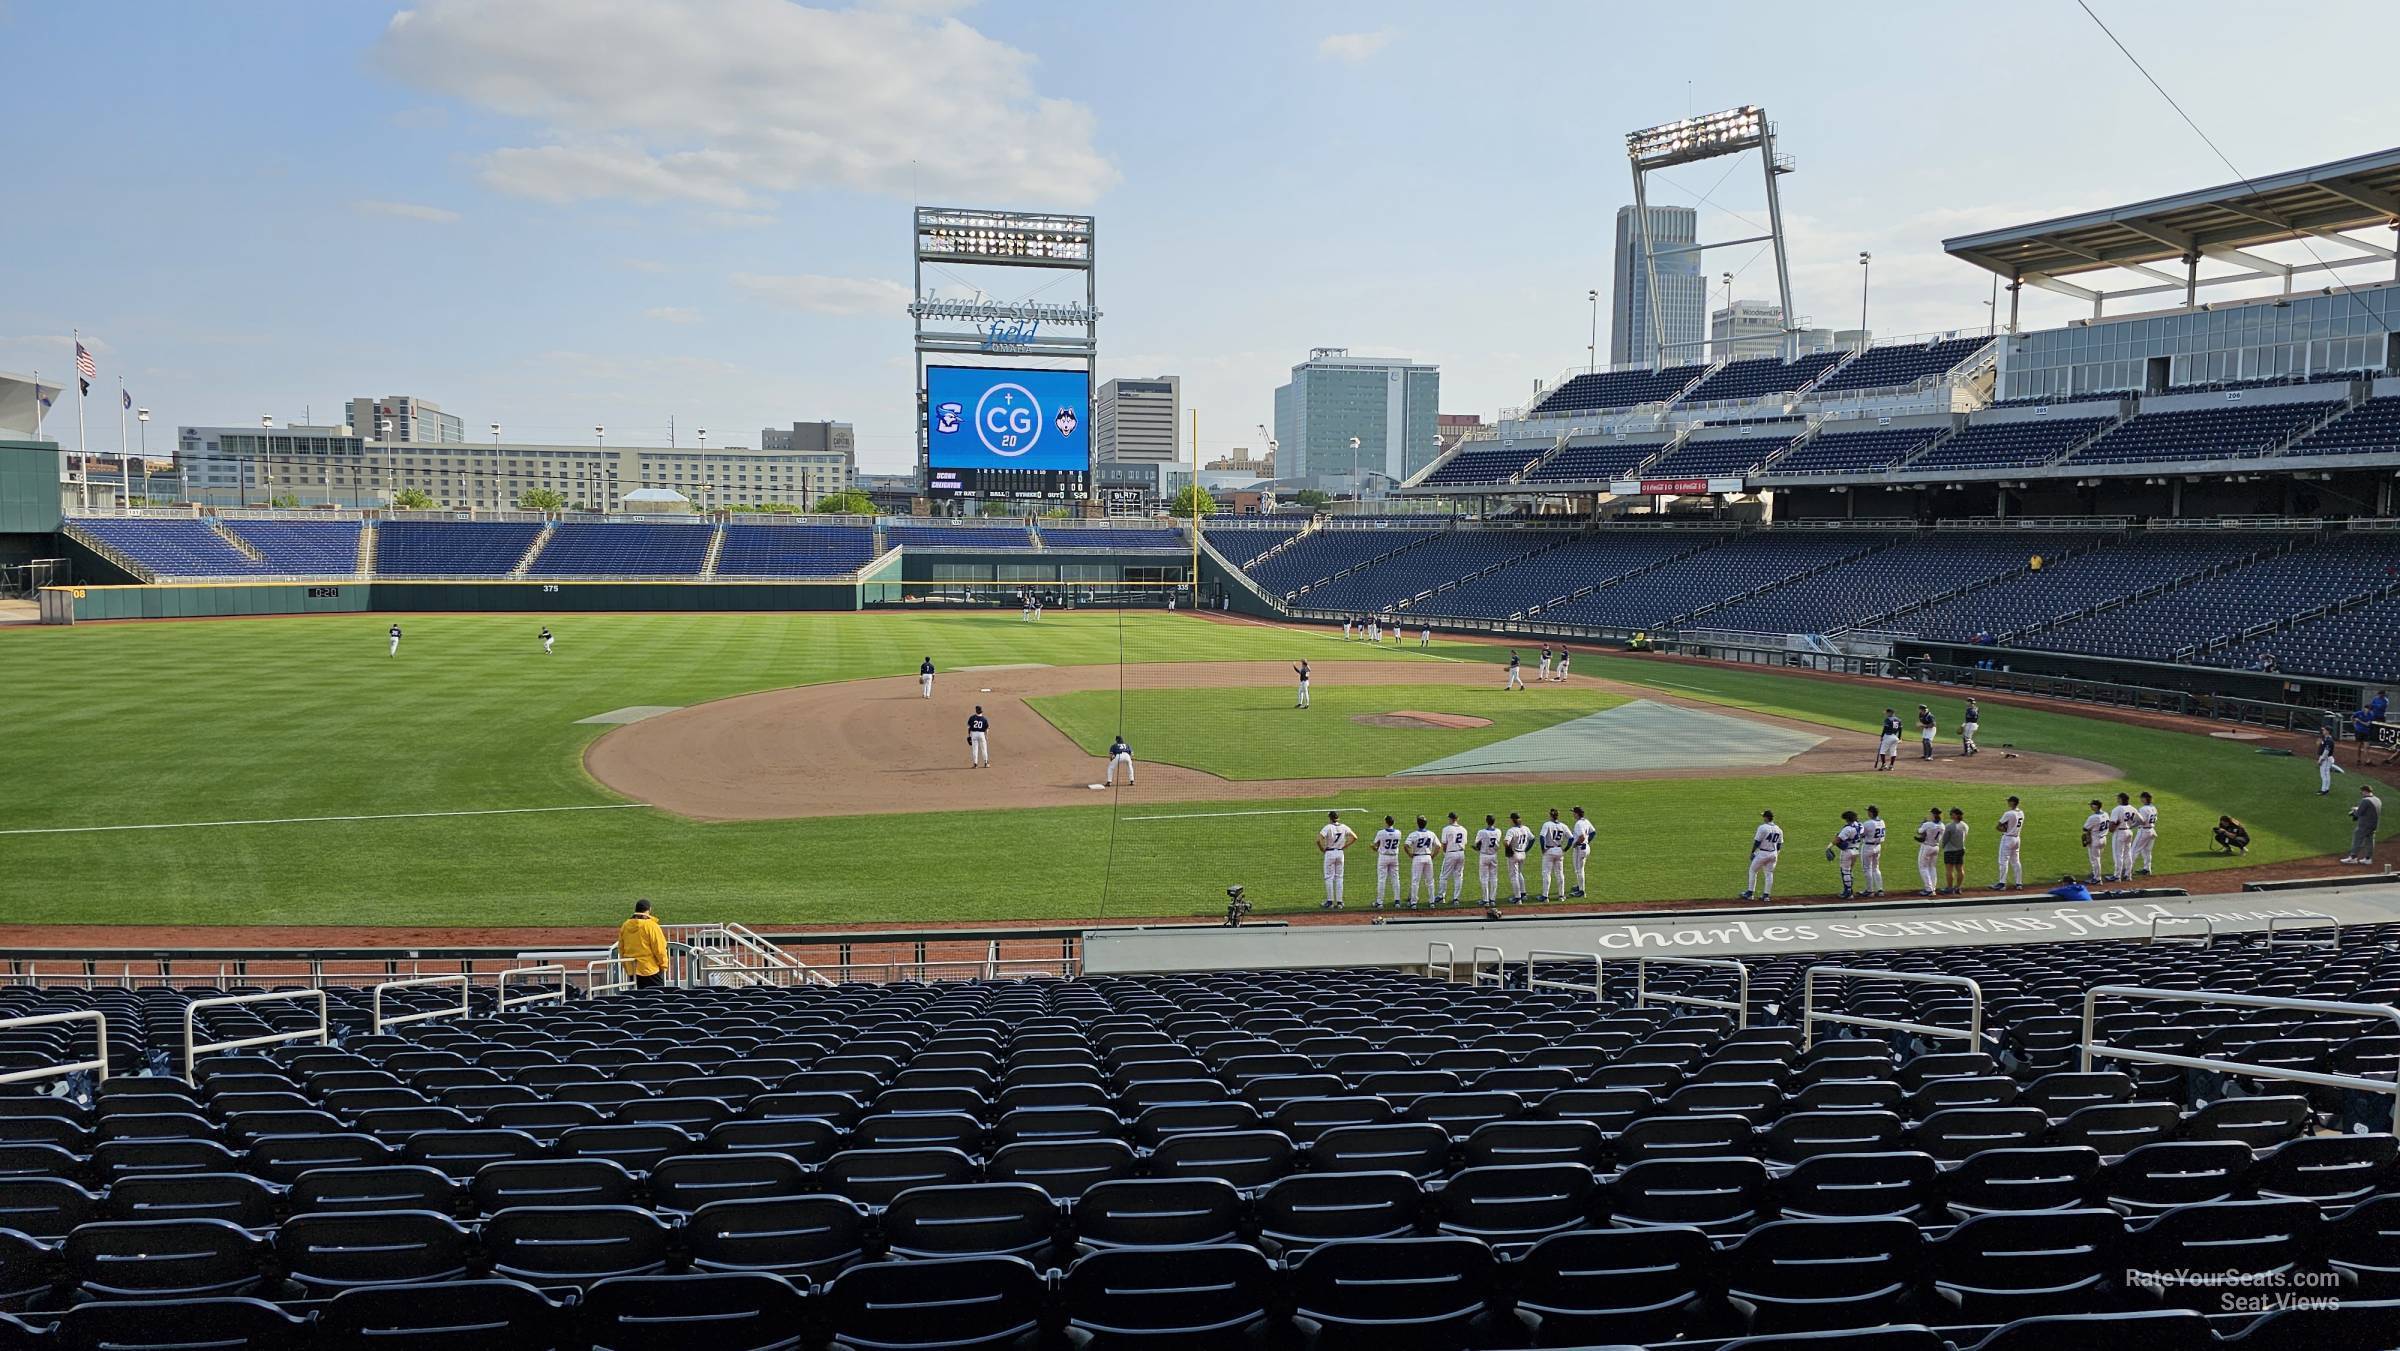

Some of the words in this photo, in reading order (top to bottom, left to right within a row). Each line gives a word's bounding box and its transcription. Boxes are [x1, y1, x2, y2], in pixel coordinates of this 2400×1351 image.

[912, 288, 1001, 317] charles
[1009, 300, 1099, 322] SCHWAB
[981, 320, 1040, 350] field
[986, 407, 1031, 434] CG
[1002, 435, 1017, 447] 20
[1114, 492, 1138, 500] BLATT
[316, 588, 336, 596] 0:20
[973, 720, 983, 728] 20
[1334, 832, 1343, 844] 7
[1455, 833, 1463, 844] 2
[1552, 830, 1564, 840] 15
[1766, 832, 1780, 843] 40
[1384, 838, 1398, 850] 32
[1417, 838, 1431, 848] 24
[1489, 838, 1496, 848] 3
[1598, 921, 1820, 949] charles
[1828, 916, 2056, 939] SCHWAB
[2050, 904, 2190, 936] field
[2193, 908, 2329, 923] OMAHA
